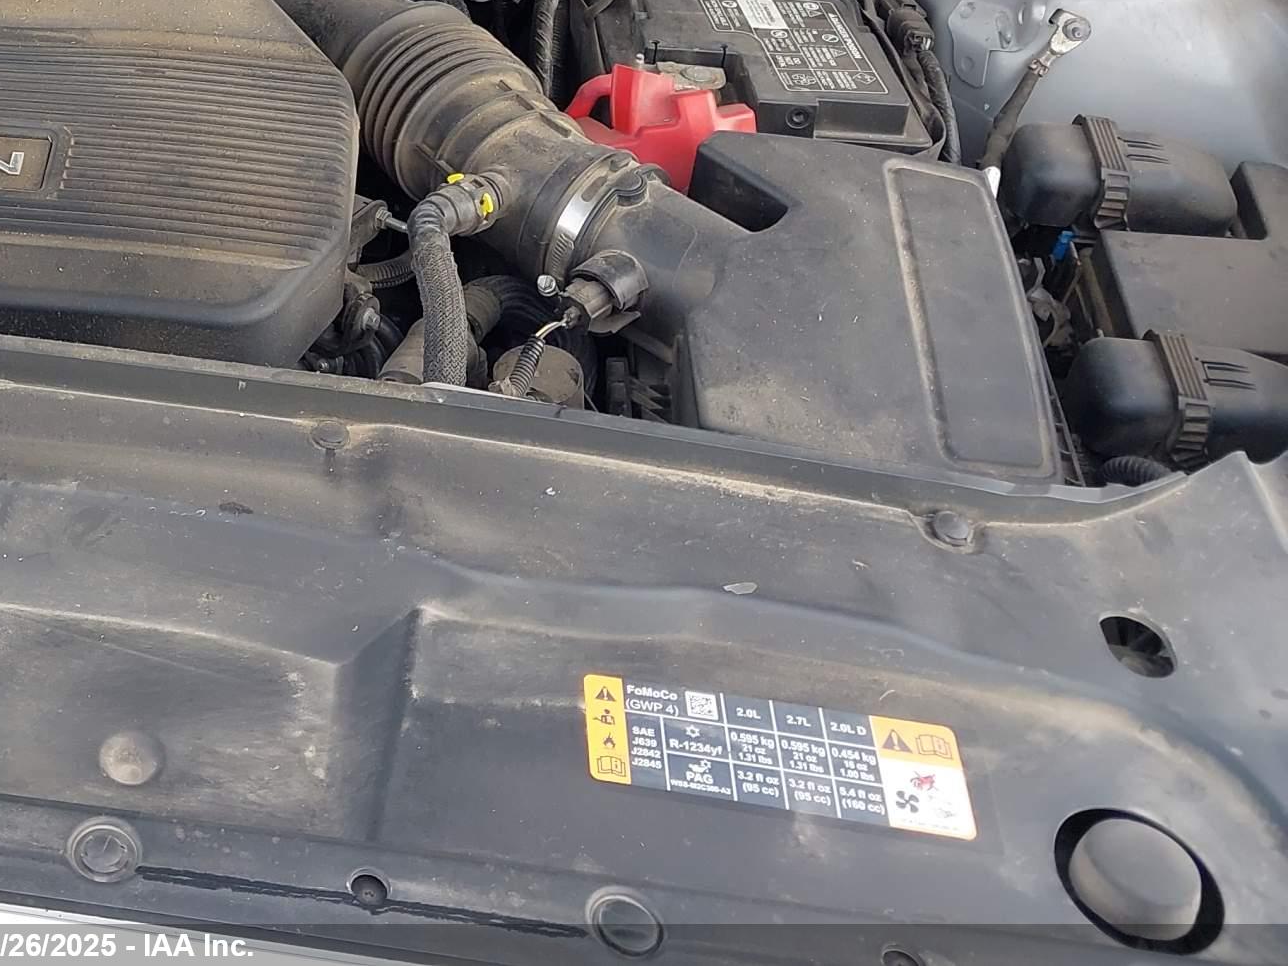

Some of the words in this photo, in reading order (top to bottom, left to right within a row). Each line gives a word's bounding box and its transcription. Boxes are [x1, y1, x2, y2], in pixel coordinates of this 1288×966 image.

[626, 684, 678, 700] FoMoCo
[626, 698, 663, 712] (GWP
[665, 704, 679, 717] 4)
[736, 708, 762, 720] 2.0L
[786, 714, 812, 727] 2.7L
[632, 726, 656, 737] SAE
[830, 722, 856, 734] 2.0L
[856, 726, 866, 736] D
[632, 736, 658, 748] J639
[669, 738, 723, 756] R-1234yf
[730, 731, 759, 745] 0.595
[760, 736, 775, 750] kg
[631, 746, 662, 758] J2842
[742, 744, 753, 752] 21
[781, 739, 810, 752] 0.595
[811, 744, 826, 758] kg
[738, 752, 757, 762] 1.31
[758, 755, 773, 765] lbs
[792, 752, 804, 760] 21
[806, 754, 818, 762] oz
[832, 747, 860, 760] 0.454
[861, 752, 876, 766] kg
[632, 758, 662, 770] J2845
[790, 760, 808, 771] 1.31
[808, 764, 825, 773] lbs
[856, 764, 868, 772] oz
[686, 770, 714, 784] PAG
[737, 770, 754, 781] 3.2
[756, 773, 764, 782] fl
[765, 776, 780, 785] oz
[840, 768, 859, 779] 1.00
[860, 772, 876, 782] lbs
[742, 782, 760, 794] (95
[762, 786, 779, 798] cc)
[788, 778, 806, 789] 3.2
[806, 781, 816, 791] fl
[816, 784, 832, 794] oz
[794, 790, 812, 802] (95
[812, 794, 831, 806] cc)
[857, 790, 866, 799] fl
[867, 793, 882, 802] oz
[867, 802, 885, 816] cc)
